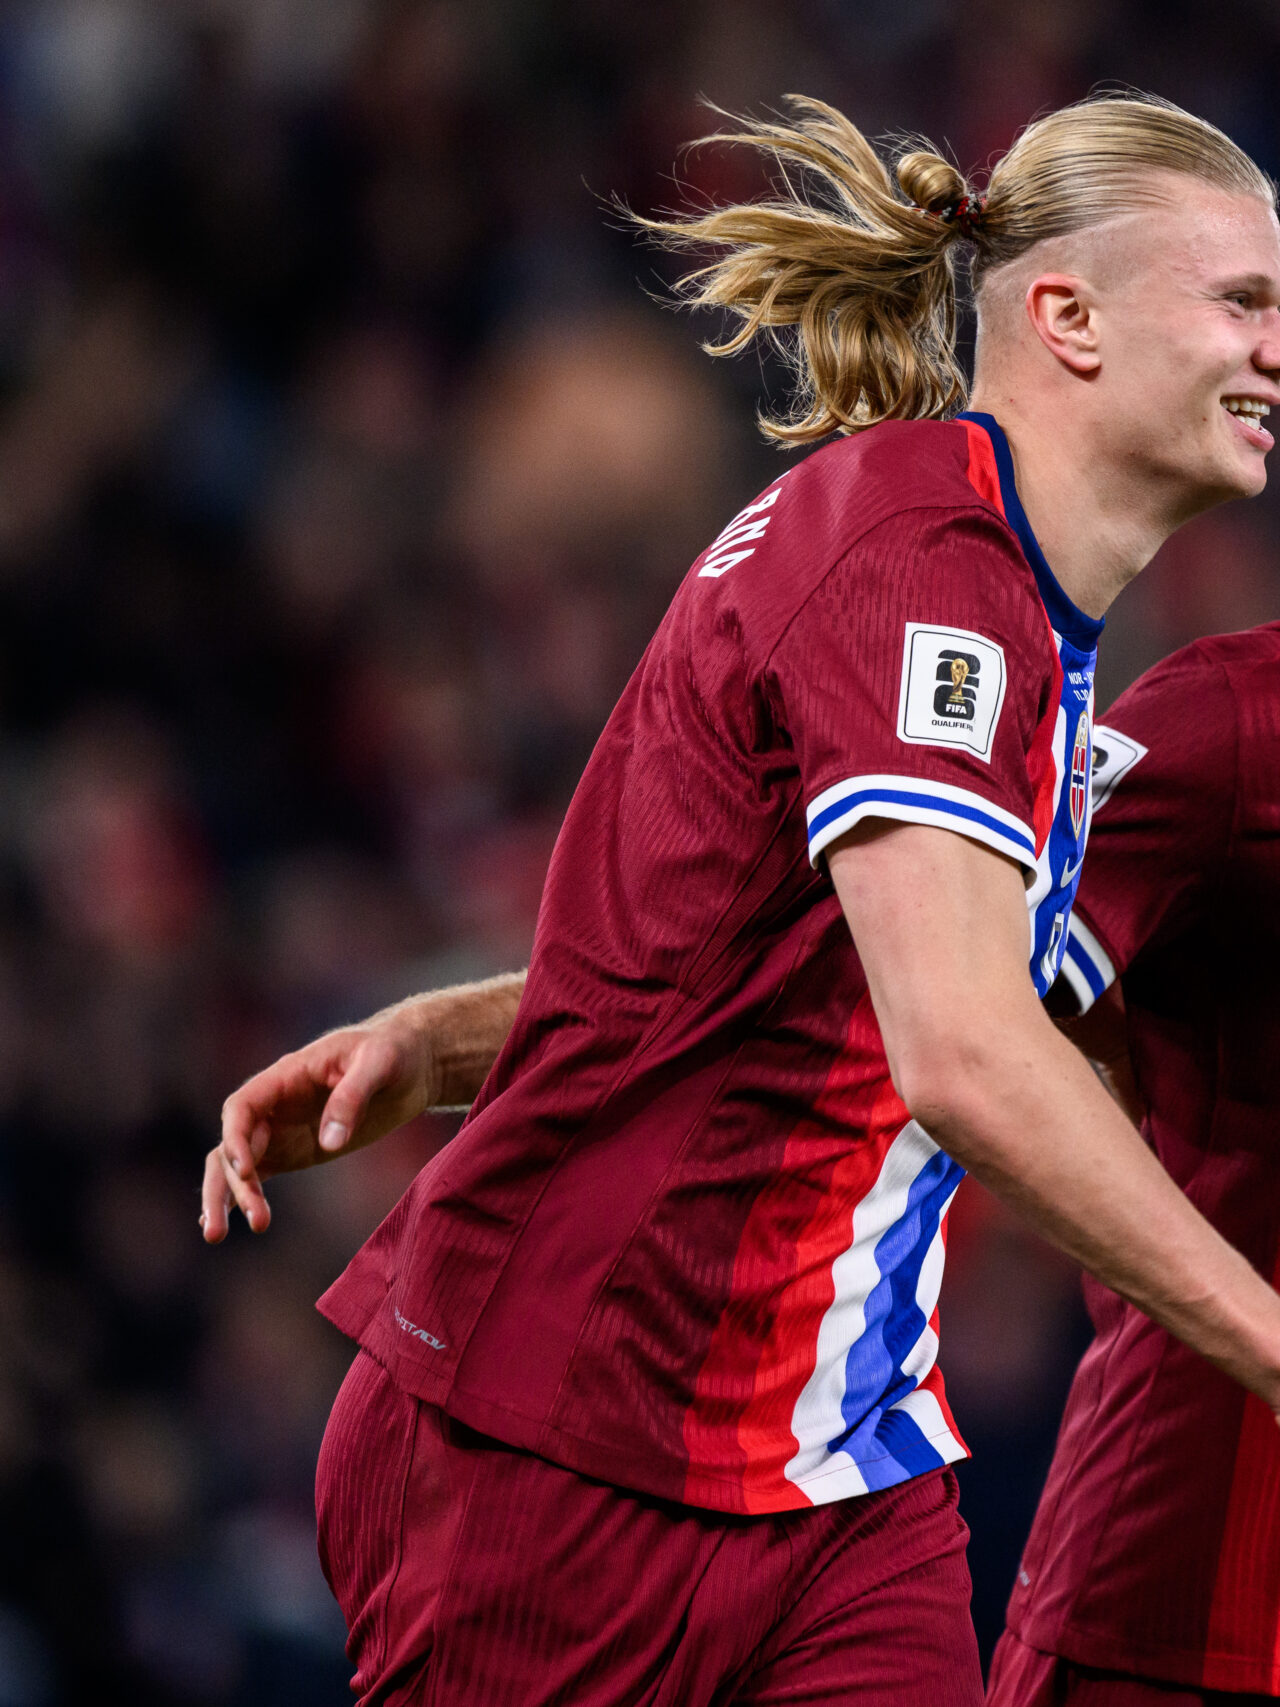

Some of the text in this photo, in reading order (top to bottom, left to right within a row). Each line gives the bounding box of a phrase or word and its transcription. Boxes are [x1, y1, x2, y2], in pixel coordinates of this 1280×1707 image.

[1068, 672, 1084, 684] NOR
[945, 703, 967, 715] FIFA
[931, 719, 974, 733] QUALIFIERS
